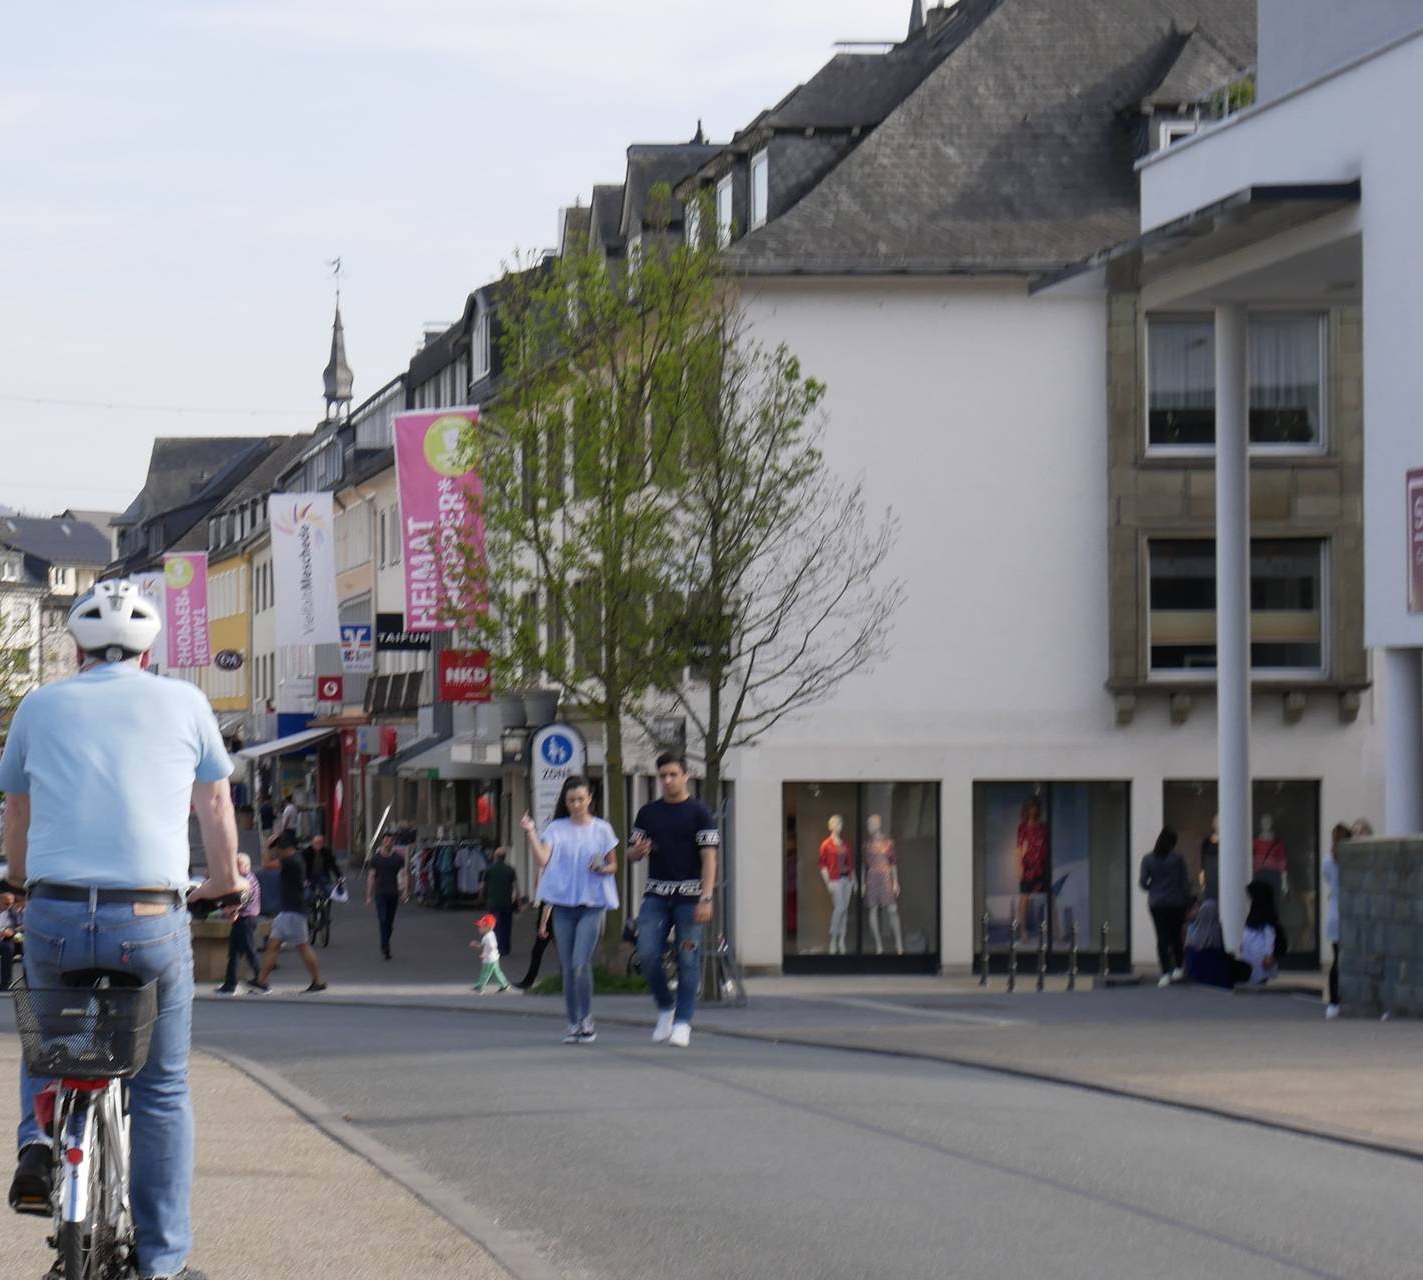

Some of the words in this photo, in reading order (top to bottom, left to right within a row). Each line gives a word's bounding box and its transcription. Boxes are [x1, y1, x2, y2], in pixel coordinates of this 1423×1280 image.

[408, 515, 437, 629] HEIMAT
[377, 631, 431, 645] TAIFUN
[445, 666, 488, 684] NKD
